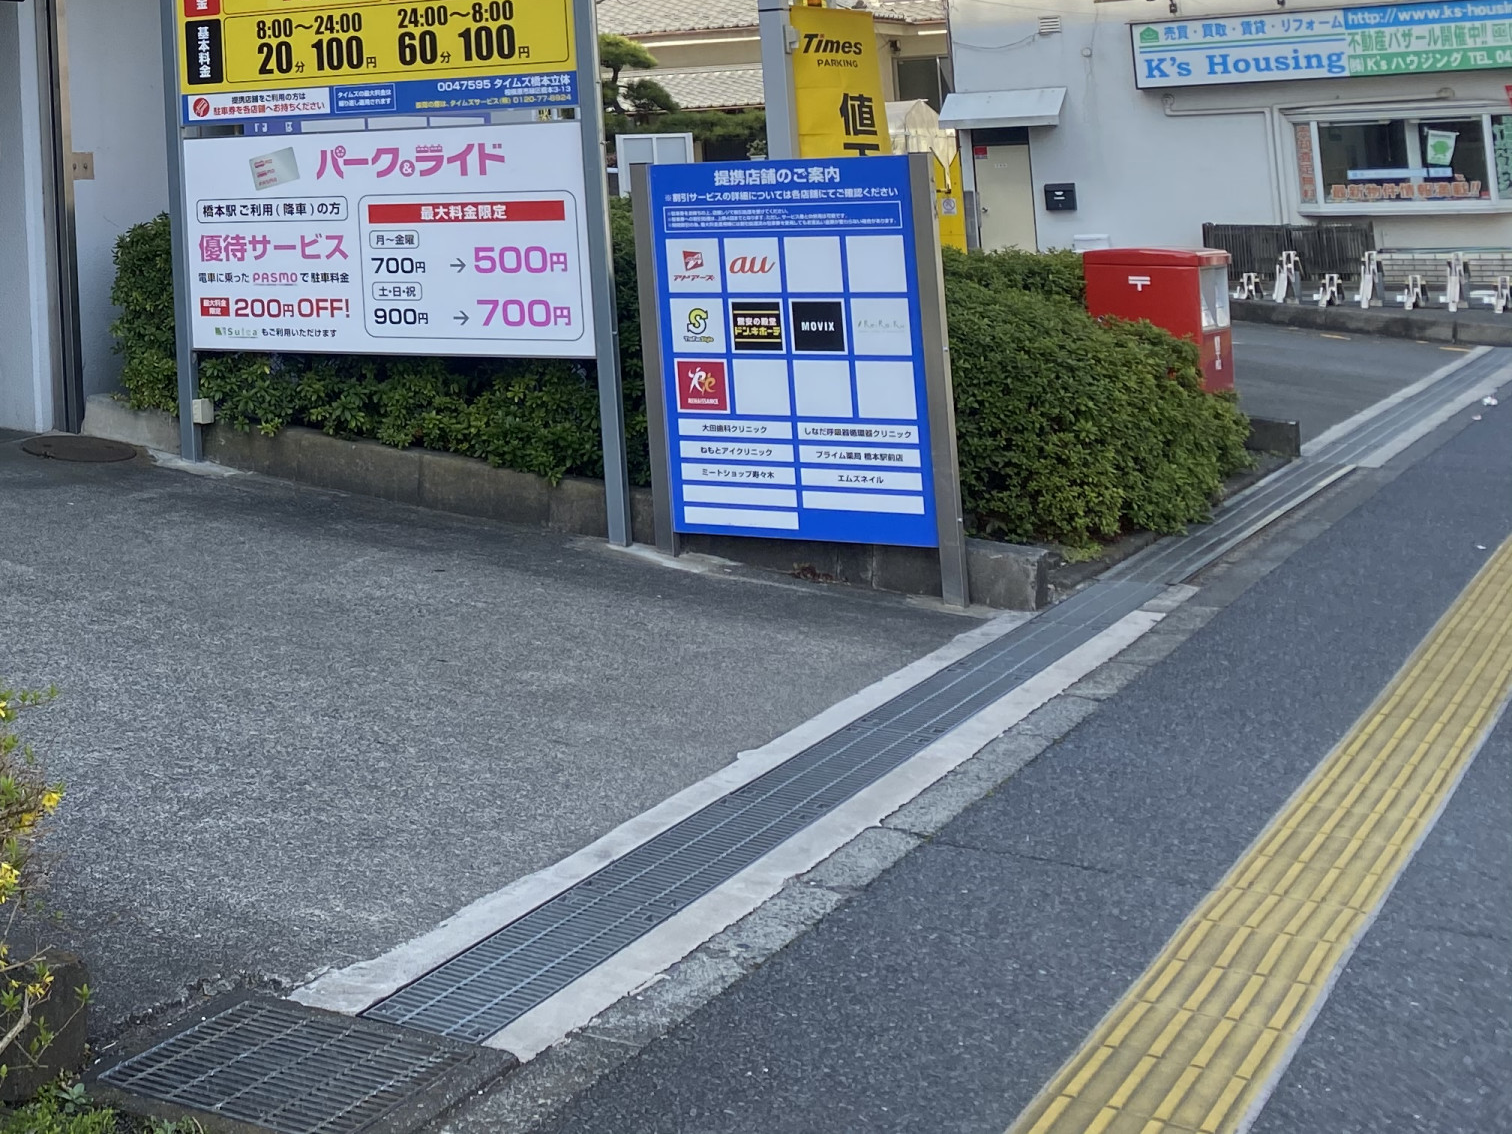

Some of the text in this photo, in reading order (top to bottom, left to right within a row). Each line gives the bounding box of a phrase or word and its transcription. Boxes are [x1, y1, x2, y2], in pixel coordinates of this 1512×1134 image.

[197, 26, 211, 78] 基本料金
[398, 24, 531, 66] 60分 100円
[802, 33, 863, 55] Times
[258, 35, 377, 75] 20分 100円
[817, 59, 858, 68] PARKING
[1392, 51, 1462, 70] ハウジング
[1145, 49, 1346, 80] K's Housing
[437, 74, 571, 92] 0047595 タイムズ橋本立体
[232, 93, 306, 105] 提携店舗をご利用の方は
[213, 102, 325, 116] 駐車券を各店舗へお持ちください
[316, 143, 505, 180] パーク&ライド
[714, 166, 839, 187] 提携店舗のご案内
[420, 204, 507, 221] 最大料金限定
[199, 233, 348, 262] 優待サービス
[371, 244, 568, 275] 700円 500円
[729, 256, 776, 274] au
[199, 272, 249, 284] 電車に乗った
[253, 272, 298, 283] PASMO
[234, 298, 350, 318] 200円 OFF!
[374, 298, 571, 327] 900円 700円
[262, 327, 337, 337] もご利用いただけます
[801, 321, 835, 331] MOVIX
[700, 446, 773, 457] ねもとアイクリニック
[816, 451, 861, 461] プライム薬局
[838, 474, 884, 484] エムズネイル
